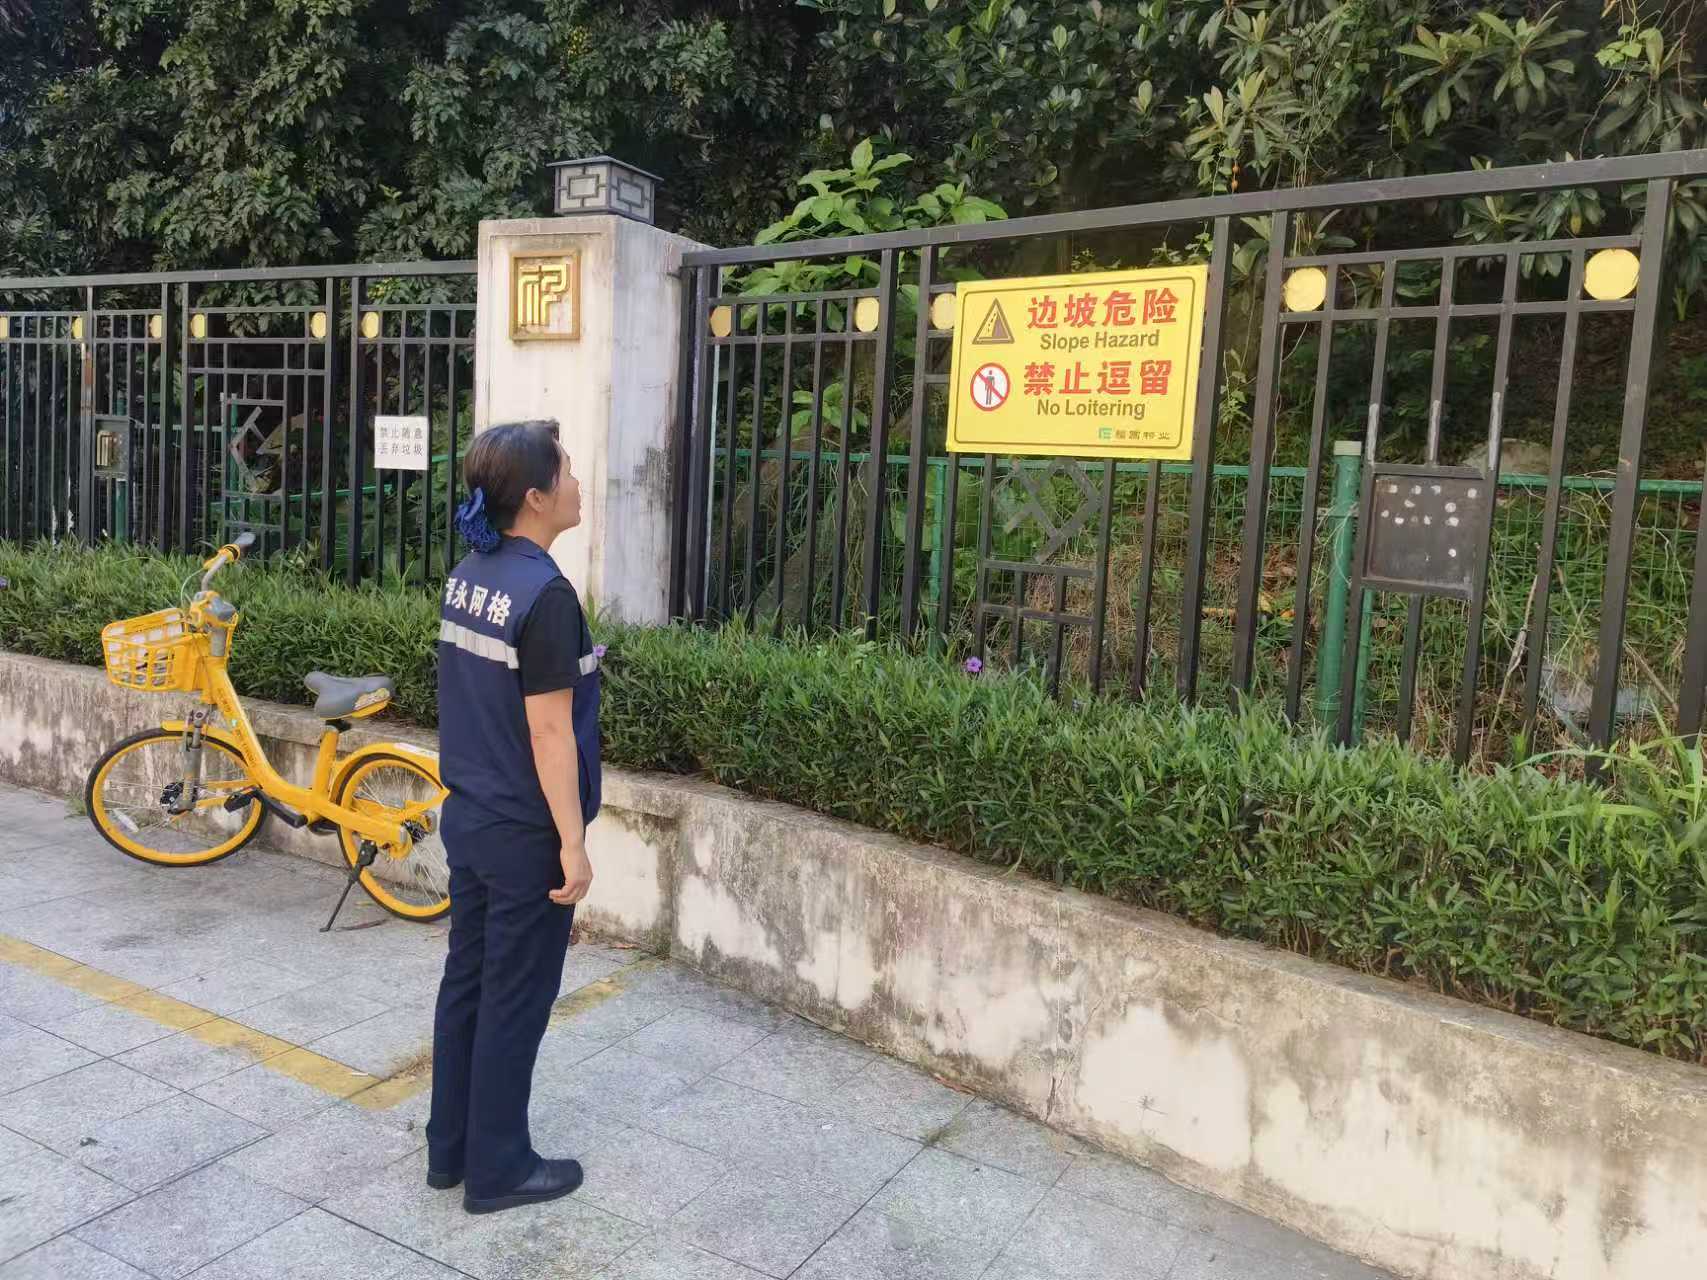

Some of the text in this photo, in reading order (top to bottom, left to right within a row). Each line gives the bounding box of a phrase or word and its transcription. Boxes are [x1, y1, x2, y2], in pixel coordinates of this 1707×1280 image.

[1027, 287, 1179, 330] 边坡危险
[1040, 329, 1160, 353] Slope Hazard
[1023, 359, 1172, 396] 禁止逗留
[1037, 399, 1146, 421] No Loitering
